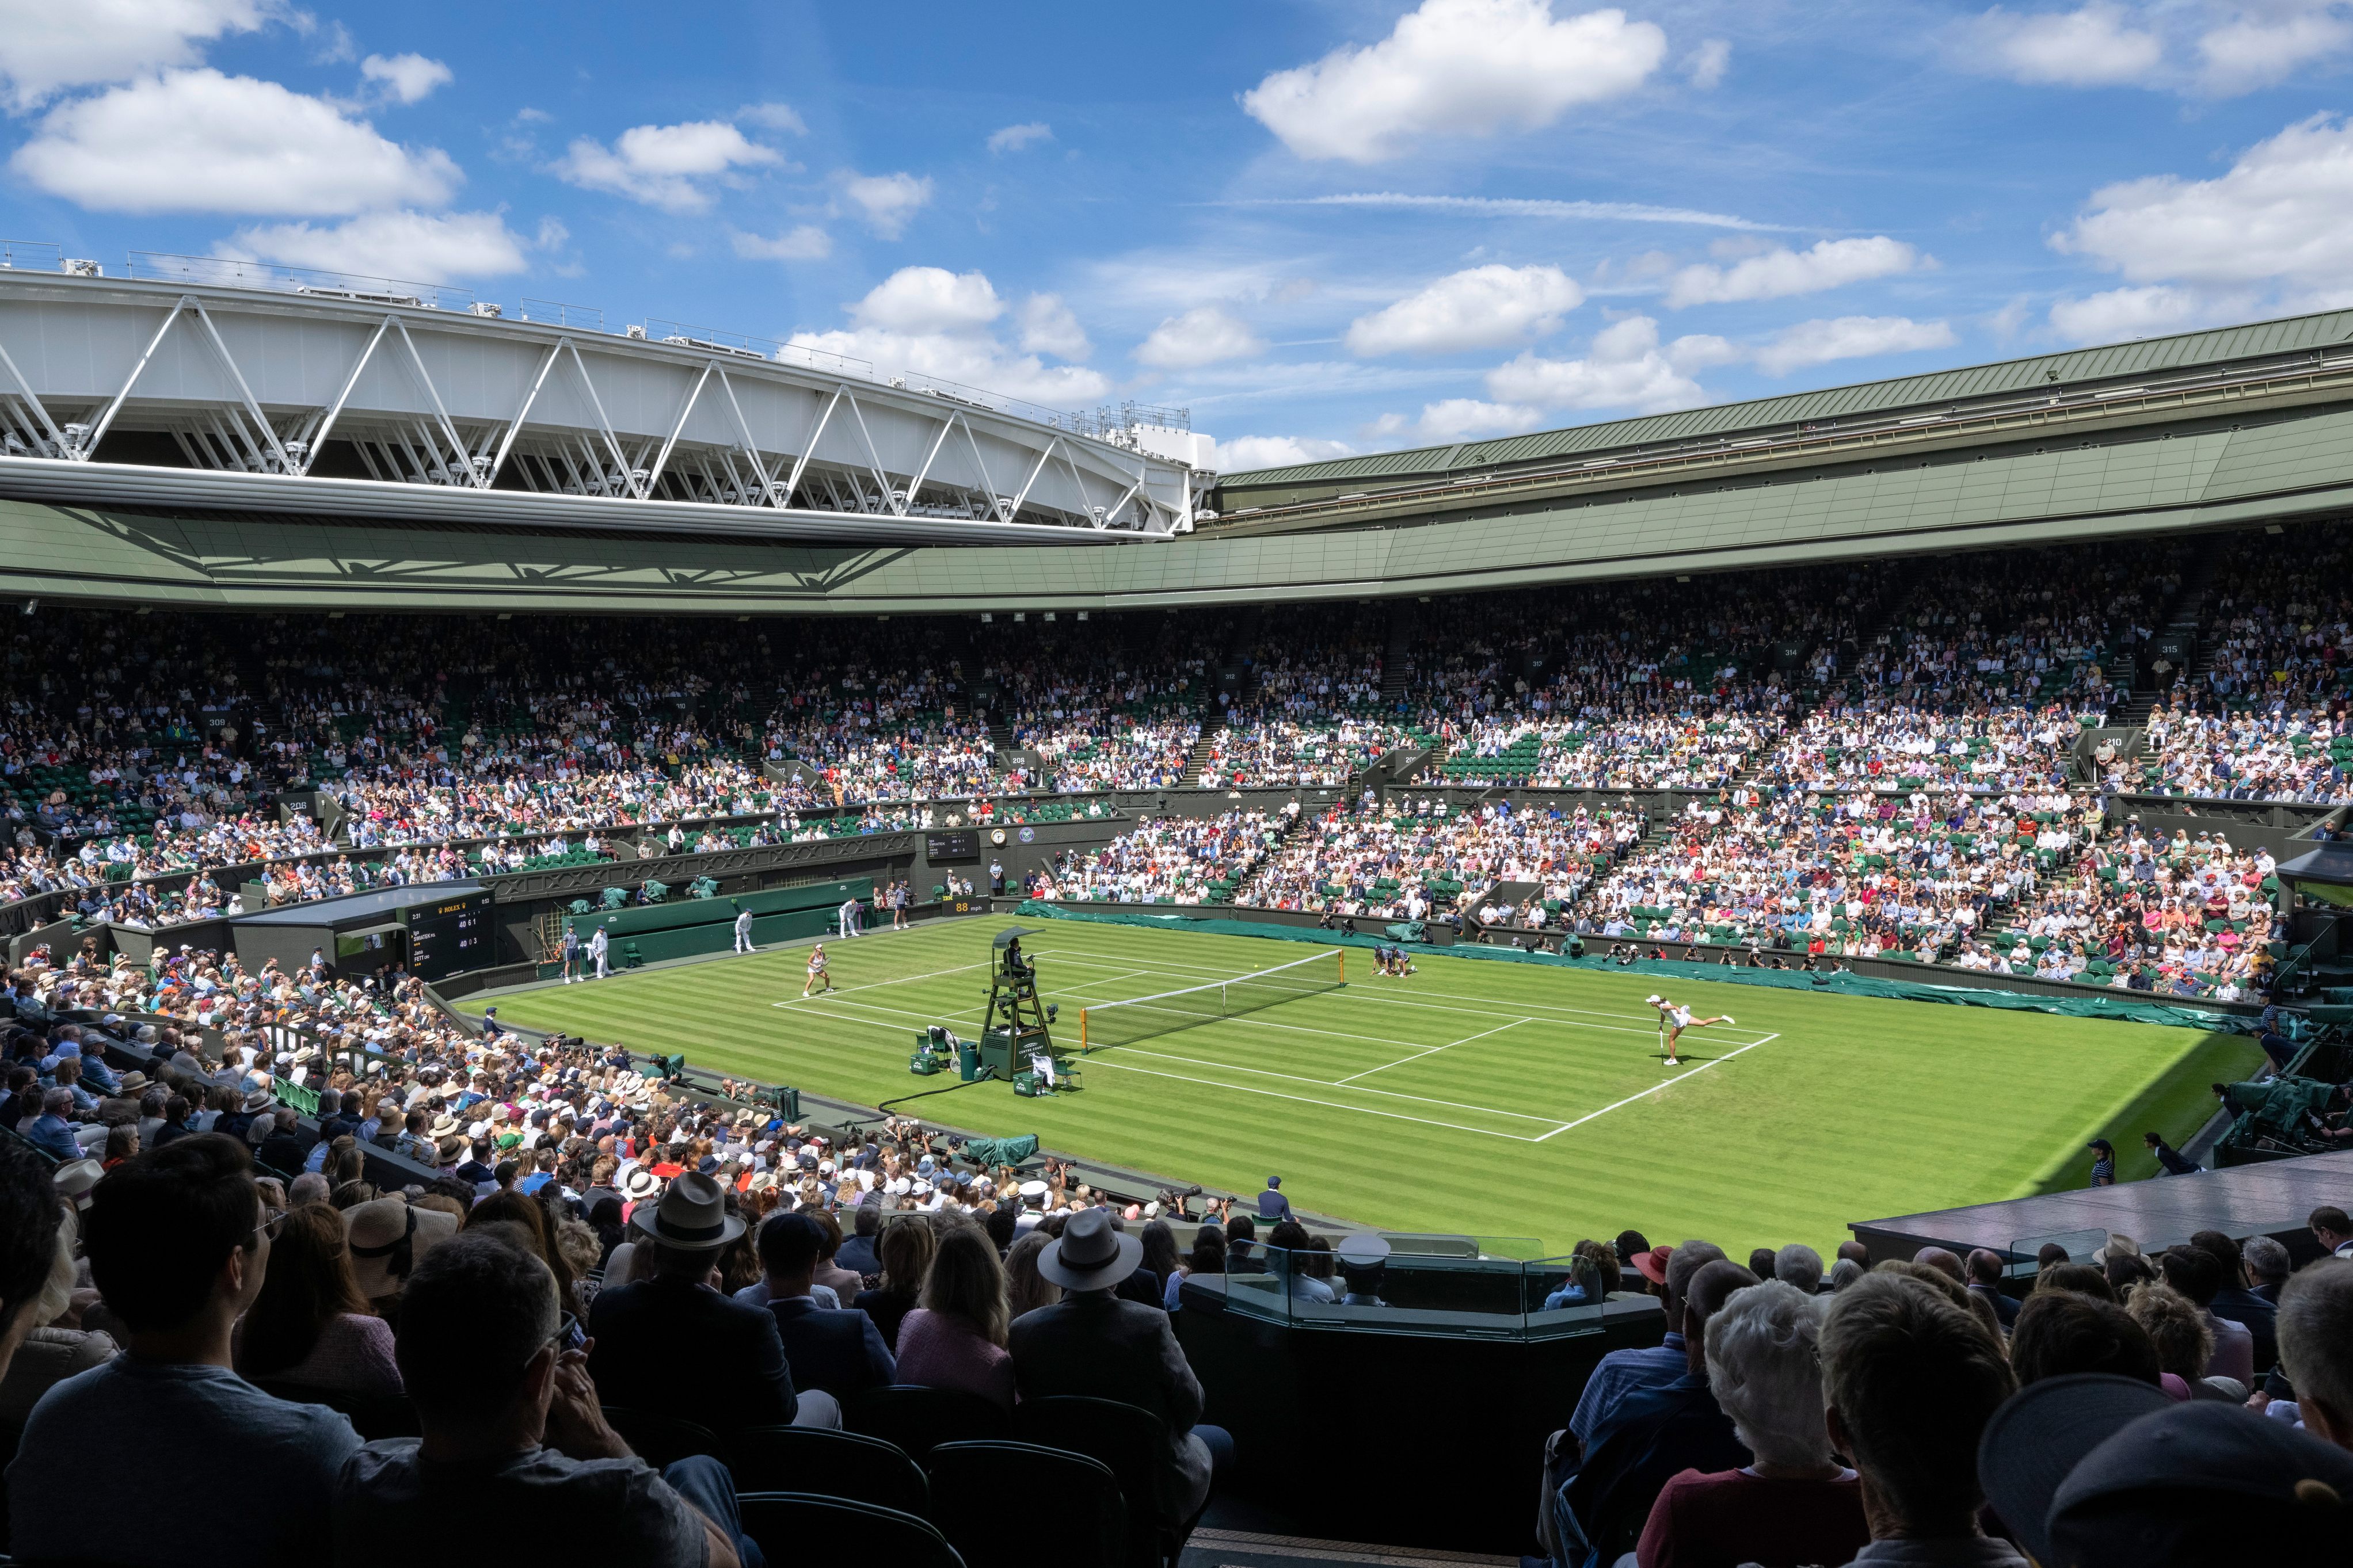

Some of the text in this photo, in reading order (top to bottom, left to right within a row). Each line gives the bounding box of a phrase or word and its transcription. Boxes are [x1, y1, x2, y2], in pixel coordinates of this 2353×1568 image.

[290, 802, 307, 810] 206
[444, 904, 460, 913] ROLEX
[956, 902, 968, 912] 88
[413, 933, 431, 942] SWIATEK
